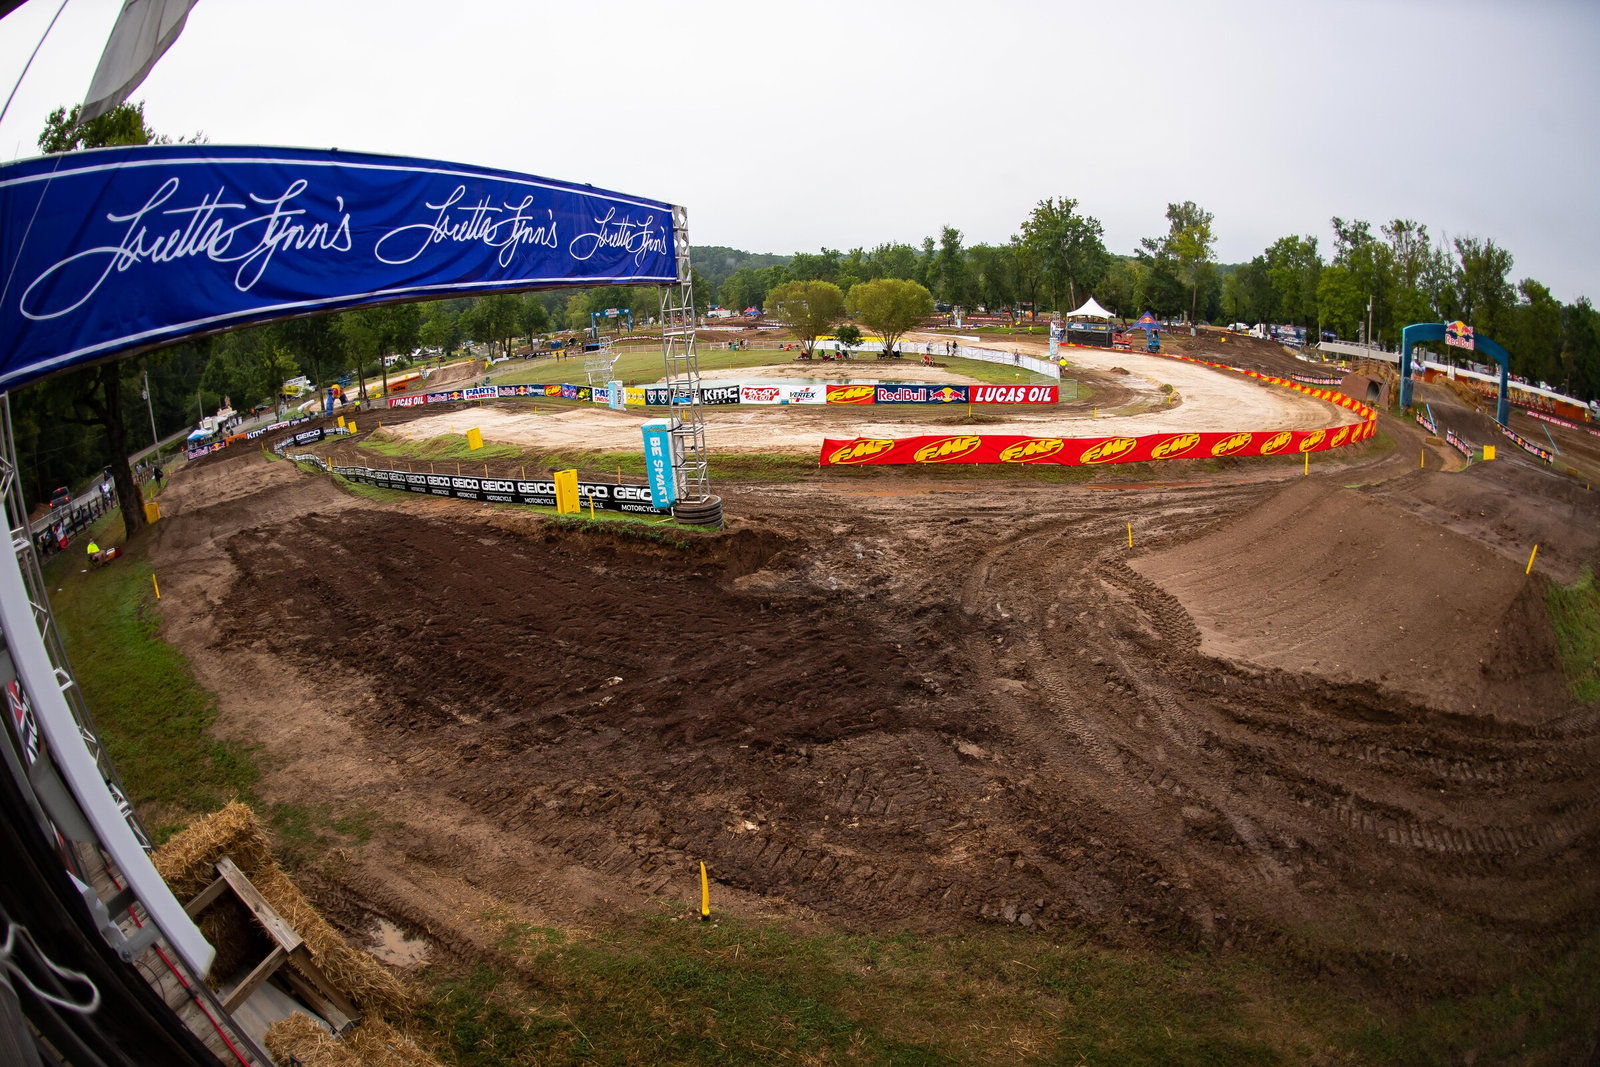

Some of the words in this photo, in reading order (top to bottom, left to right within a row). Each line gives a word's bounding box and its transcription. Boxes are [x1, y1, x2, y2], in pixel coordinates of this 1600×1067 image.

[375, 185, 503, 264] Loretta
[486, 195, 558, 267] Lynn's
[569, 207, 637, 260] Loretta
[20, 178, 246, 320] Loretta
[208, 179, 352, 292] Lynn's
[466, 387, 497, 395] PARTS
[704, 387, 738, 400] KMC
[828, 387, 875, 401] FMF
[975, 387, 1025, 403] LUCAS
[1028, 387, 1052, 402] OIL
[392, 397, 413, 407] LUCAS
[413, 396, 425, 405] OIL
[295, 429, 321, 441] GEICO
[650, 437, 662, 457] BE
[915, 436, 980, 463] FMF
[1000, 439, 1063, 462] FMF
[1151, 434, 1200, 459] FMF
[1211, 432, 1251, 456] FMF
[1261, 431, 1291, 455] FMF
[830, 440, 895, 464] FMF
[1080, 438, 1136, 464] FMF
[389, 472, 405, 482] GEICO
[406, 475, 426, 484] GEICO
[427, 475, 450, 486] GEICO
[452, 478, 479, 490] GEICO
[653, 460, 670, 504] SMART
[482, 480, 514, 492] GEICO
[578, 485, 608, 498] EICO
[613, 486, 652, 501] GEIC
[457, 491, 478, 499] MOTORCYCLE
[524, 497, 555, 505] MOTORCYCLE
